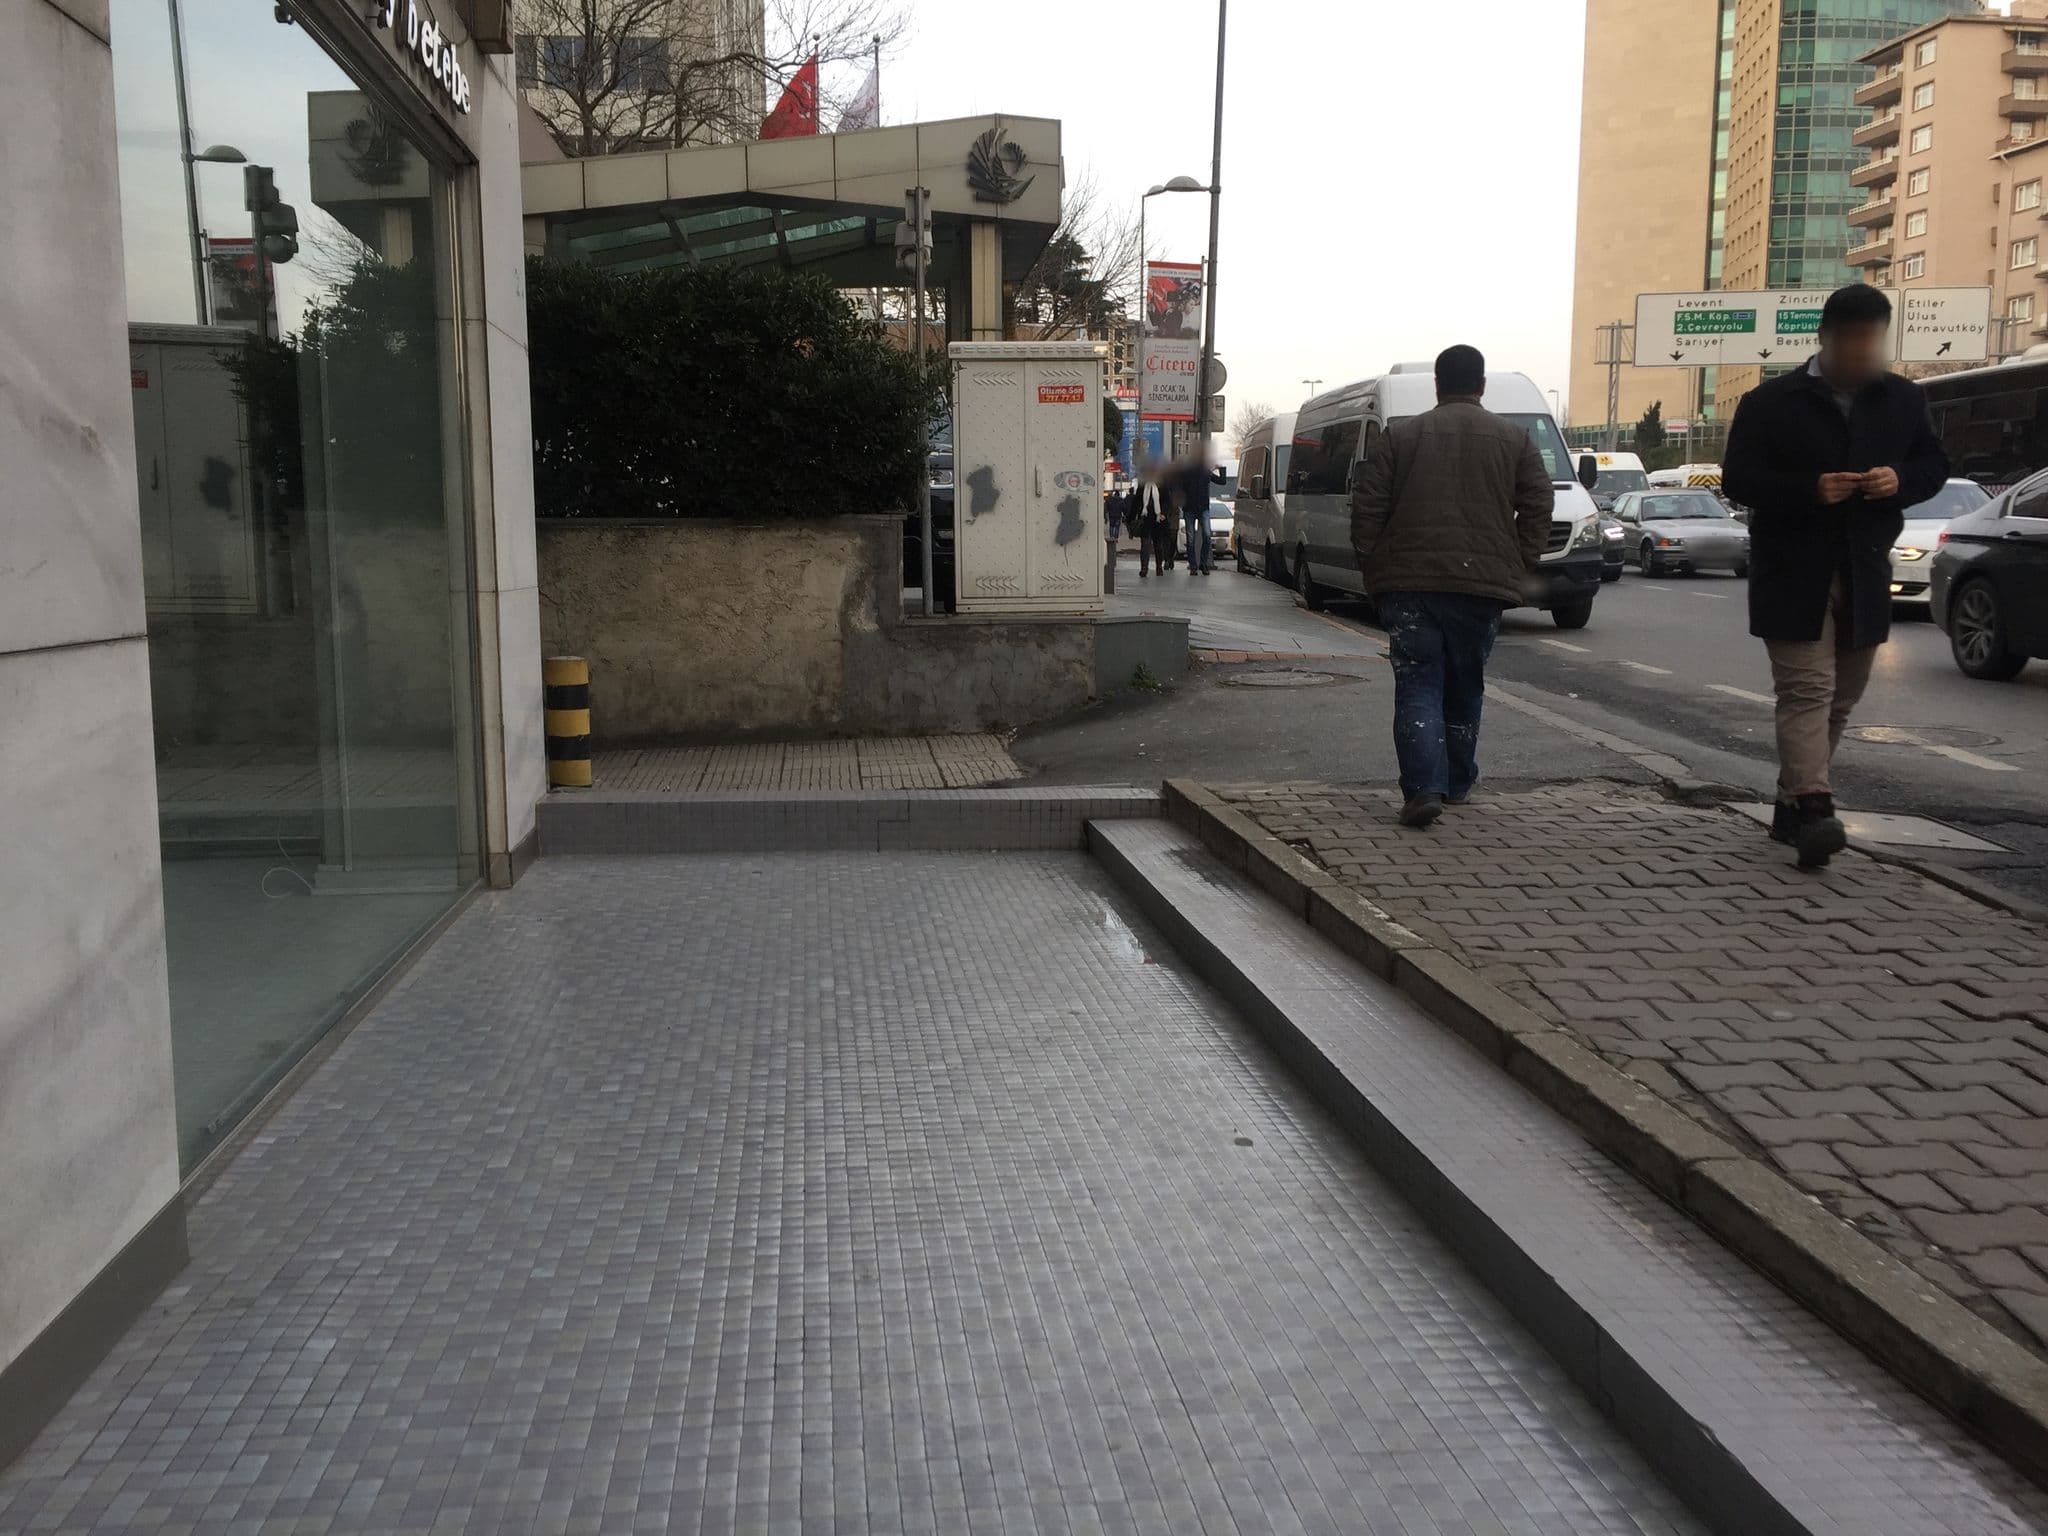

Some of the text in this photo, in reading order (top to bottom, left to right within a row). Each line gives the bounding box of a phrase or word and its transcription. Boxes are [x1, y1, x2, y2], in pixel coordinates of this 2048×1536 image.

[1678, 299, 1723, 308] Levent
[1908, 299, 1946, 308] Etiler
[1778, 311, 1789, 320] 15
[1907, 311, 1937, 321] Ulus
[1907, 324, 1985, 334] Arnavutköy
[1777, 336, 1819, 347] Beşikt
